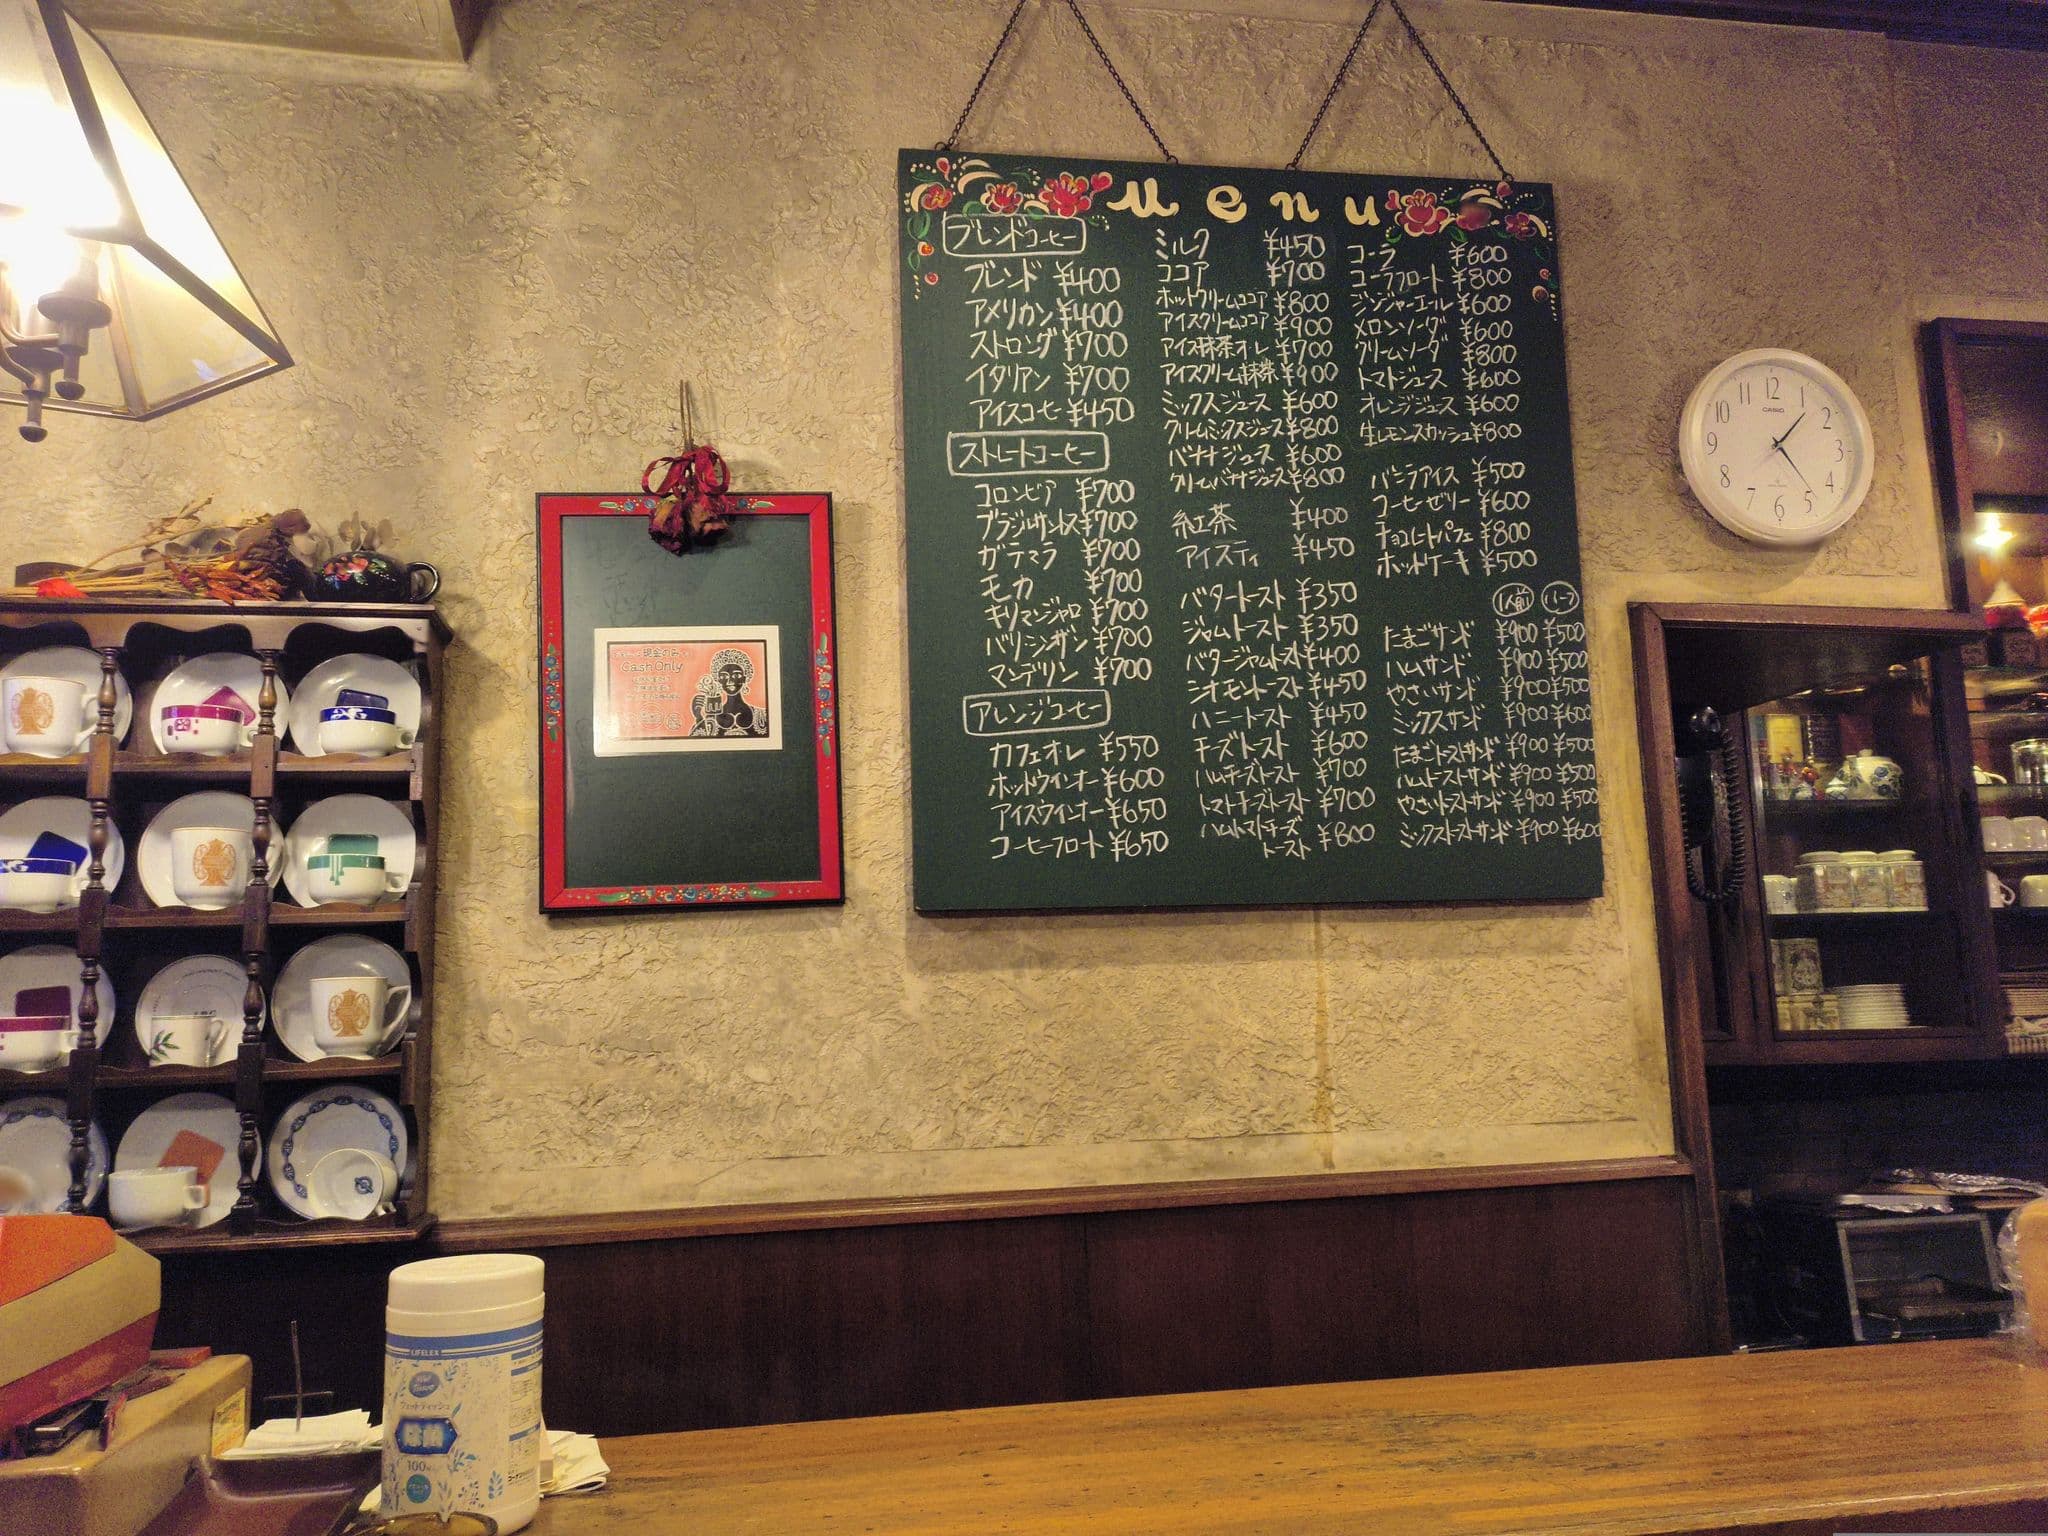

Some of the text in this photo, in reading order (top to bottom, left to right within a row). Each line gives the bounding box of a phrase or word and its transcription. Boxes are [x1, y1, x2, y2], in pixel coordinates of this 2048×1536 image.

[948, 219, 1077, 252] ブレンドコーヒー
[1155, 227, 1325, 260] ミルク ¥450
[1347, 242, 1507, 270] コーラ ¥600
[965, 258, 1120, 296] ブレンド ¥400
[1157, 257, 1325, 289] ココア ¥700
[1452, 267, 1512, 291] ¥800
[965, 298, 1124, 330] アメリカン ¥400
[1156, 286, 1329, 316] ホットクリームココア ¥800
[1350, 291, 1511, 316] ジンジャーエール ¥600
[1158, 312, 1333, 338] アイスクリームココア ¥900
[1354, 316, 1513, 342] メロンソーダ ¥600
[970, 328, 1128, 361] ストロング ¥700
[1276, 340, 1333, 365] ¥700
[1355, 335, 1517, 368] クリームソーダ ¥800
[966, 364, 1130, 395] イタリアン ¥700
[1160, 359, 1338, 388] アイスクリーム抹茶 ¥900
[1358, 365, 1521, 391] トマトジュース ¥600
[1766, 377, 1779, 400] 12
[1162, 389, 1338, 420] ミックスジュース ¥600
[1360, 393, 1519, 419] オレンジジュース ¥600
[1740, 382, 1750, 405] 11
[1067, 398, 1135, 428] ¥450
[1716, 400, 1730, 423] 10
[1822, 407, 1831, 429] 2
[1286, 415, 1338, 442] ¥800
[1360, 420, 1522, 447] 生レモンスカッシュ ¥800
[1706, 432, 1718, 455] 9
[959, 437, 1096, 468] ストレートコーヒー
[1169, 443, 1342, 470] バナナジュース ¥600
[1835, 439, 1844, 462] 3
[1288, 467, 1345, 493] ¥800
[1371, 456, 1526, 490] バニラアイス ¥500
[1720, 464, 1730, 488] 8
[1825, 471, 1833, 493] 4
[975, 477, 1135, 512] コロンビア ¥700
[1373, 490, 1530, 518] コーヒーゼリー ¥600
[1747, 488, 1756, 510] 7
[1774, 495, 1784, 518] 6
[1805, 491, 1812, 513] 5
[977, 509, 1138, 541] ブラジルサントス ¥700
[1173, 497, 1348, 539] 紅茶 ¥400
[1293, 533, 1355, 565] ¥450
[1480, 519, 1530, 550] ¥800
[978, 538, 1141, 571] ガテマラ ¥700
[1377, 549, 1538, 578] ホットケーキ ¥500
[980, 568, 1142, 602] モカ ¥700
[1181, 578, 1357, 613] バタートースト ¥350
[984, 596, 1148, 631] キリマンジャロ ¥700
[1183, 613, 1358, 644] ジャムトースト ¥350
[1092, 626, 1152, 656] ¥700
[1384, 618, 1585, 652] たまごサンド ¥900 ¥500
[621, 660, 683, 673] Cash Only
[1303, 643, 1360, 670] ¥400
[1387, 647, 1588, 678] ハムサンド ¥900 ¥500
[988, 656, 1152, 688] マンデリン ¥700
[1308, 670, 1367, 700] ¥450
[1387, 675, 1589, 706] やさいサンド ¥900 ¥500
[970, 696, 1102, 731] アレンジコーヒー
[1192, 702, 1367, 729] ハニートースト ¥450
[1393, 702, 1592, 734] ミックスサンド ¥900 ¥600
[1099, 731, 1159, 761] ¥550
[1194, 730, 1368, 763] チーズトースト ¥600
[1506, 732, 1548, 759] ¥900
[1554, 732, 1594, 757] ¥500
[1101, 766, 1164, 798] ¥600
[1196, 757, 1367, 788] ハムチーズトースト ¥700
[1509, 763, 1551, 786] ¥900
[1556, 762, 1595, 784] ¥500
[1105, 797, 1166, 829] ¥650
[1200, 785, 1375, 817] トマトチーズトースト ¥700
[1511, 789, 1555, 814] ¥900
[1561, 787, 1598, 811] ¥500
[990, 829, 1169, 862] コーヒーフロート ¥650
[1317, 822, 1375, 851] ¥800
[1516, 818, 1559, 845] ¥900
[1562, 816, 1601, 845] ¥600
[1263, 838, 1311, 860] トースト
